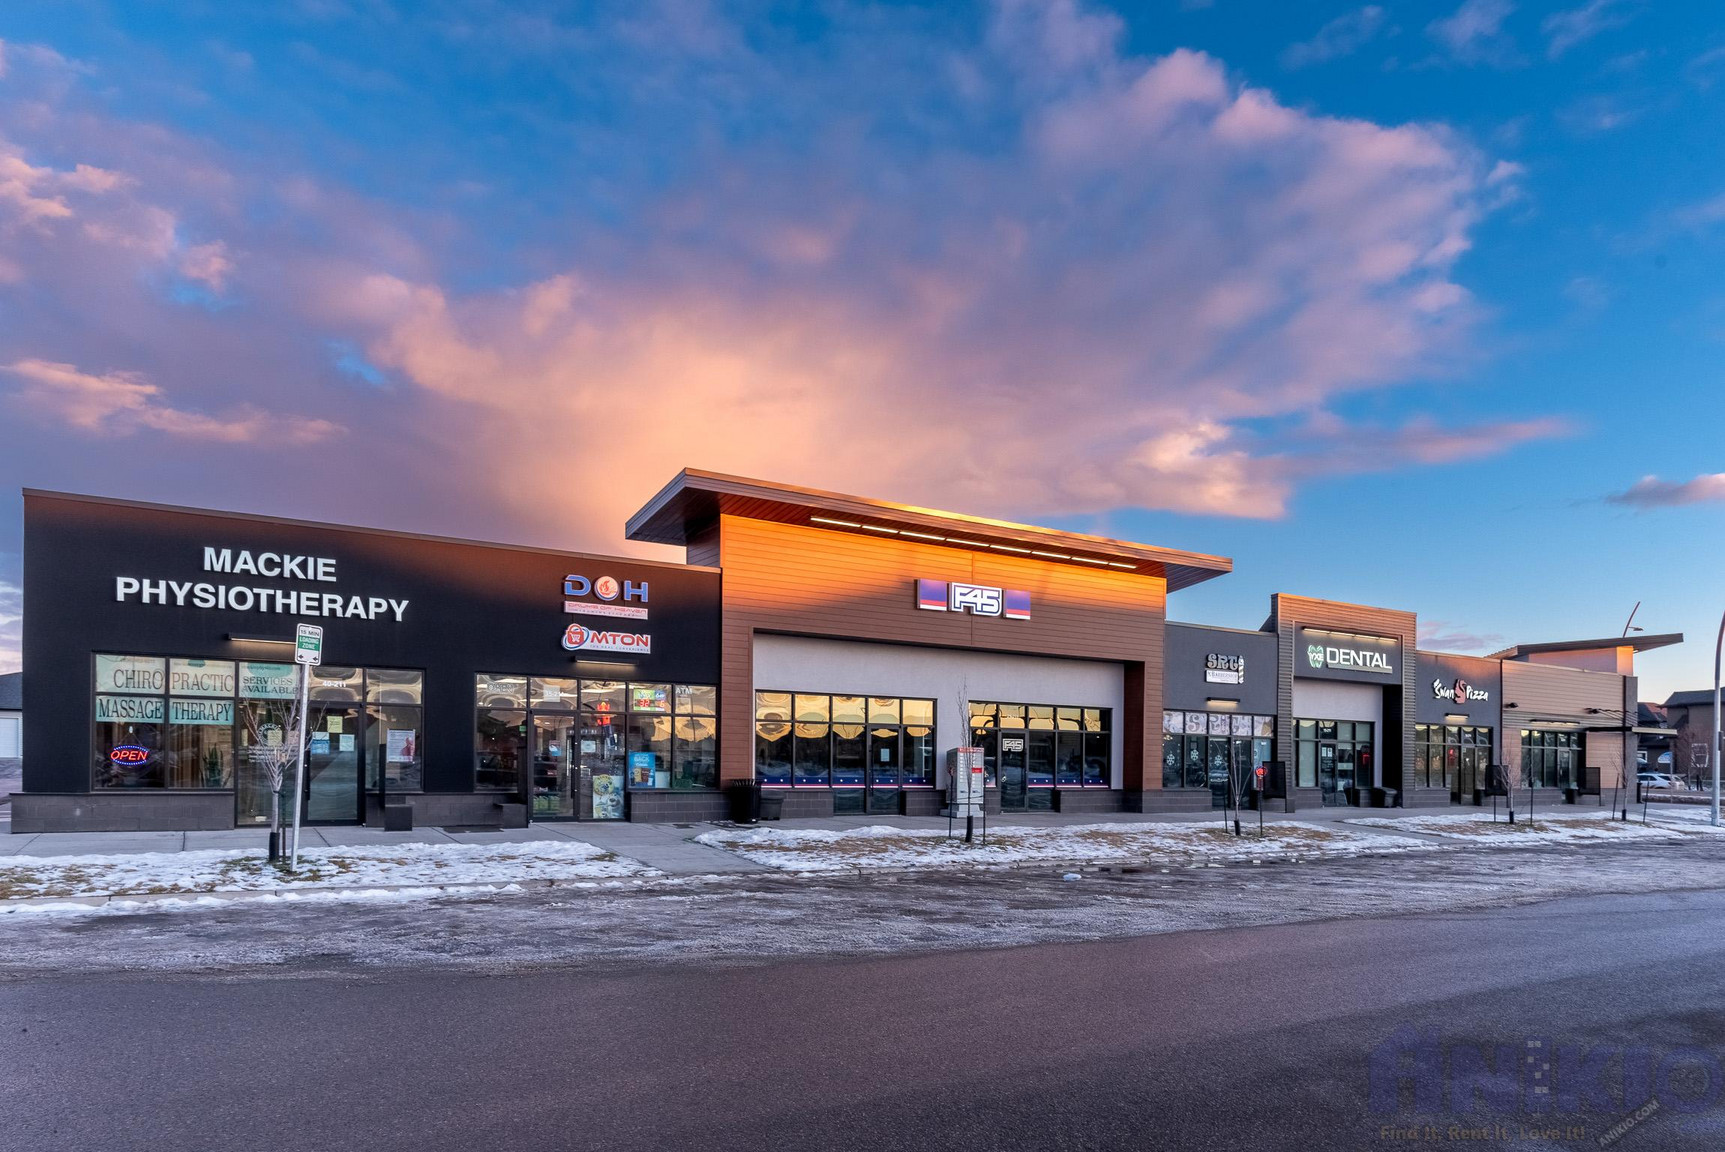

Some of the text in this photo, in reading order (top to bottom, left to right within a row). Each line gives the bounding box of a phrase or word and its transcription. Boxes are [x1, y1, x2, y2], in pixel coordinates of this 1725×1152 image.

[204, 547, 336, 582] MACKIE
[116, 576, 409, 622] PHYSIOTHERAPY
[565, 575, 648, 602] DOH
[953, 584, 1001, 615] F45
[300, 637, 319, 645] LOADING
[1326, 647, 1393, 669] DENTAL
[114, 668, 234, 692] CHIRO PRACTIC
[242, 685, 299, 695] AVAILABLE
[243, 676, 293, 686] SERVICES
[1434, 681, 1488, 701] Swan Pizza
[98, 699, 231, 721] MASSAGE THERAPY
[111, 750, 148, 760] OPEN
[1003, 739, 1024, 751] F45
